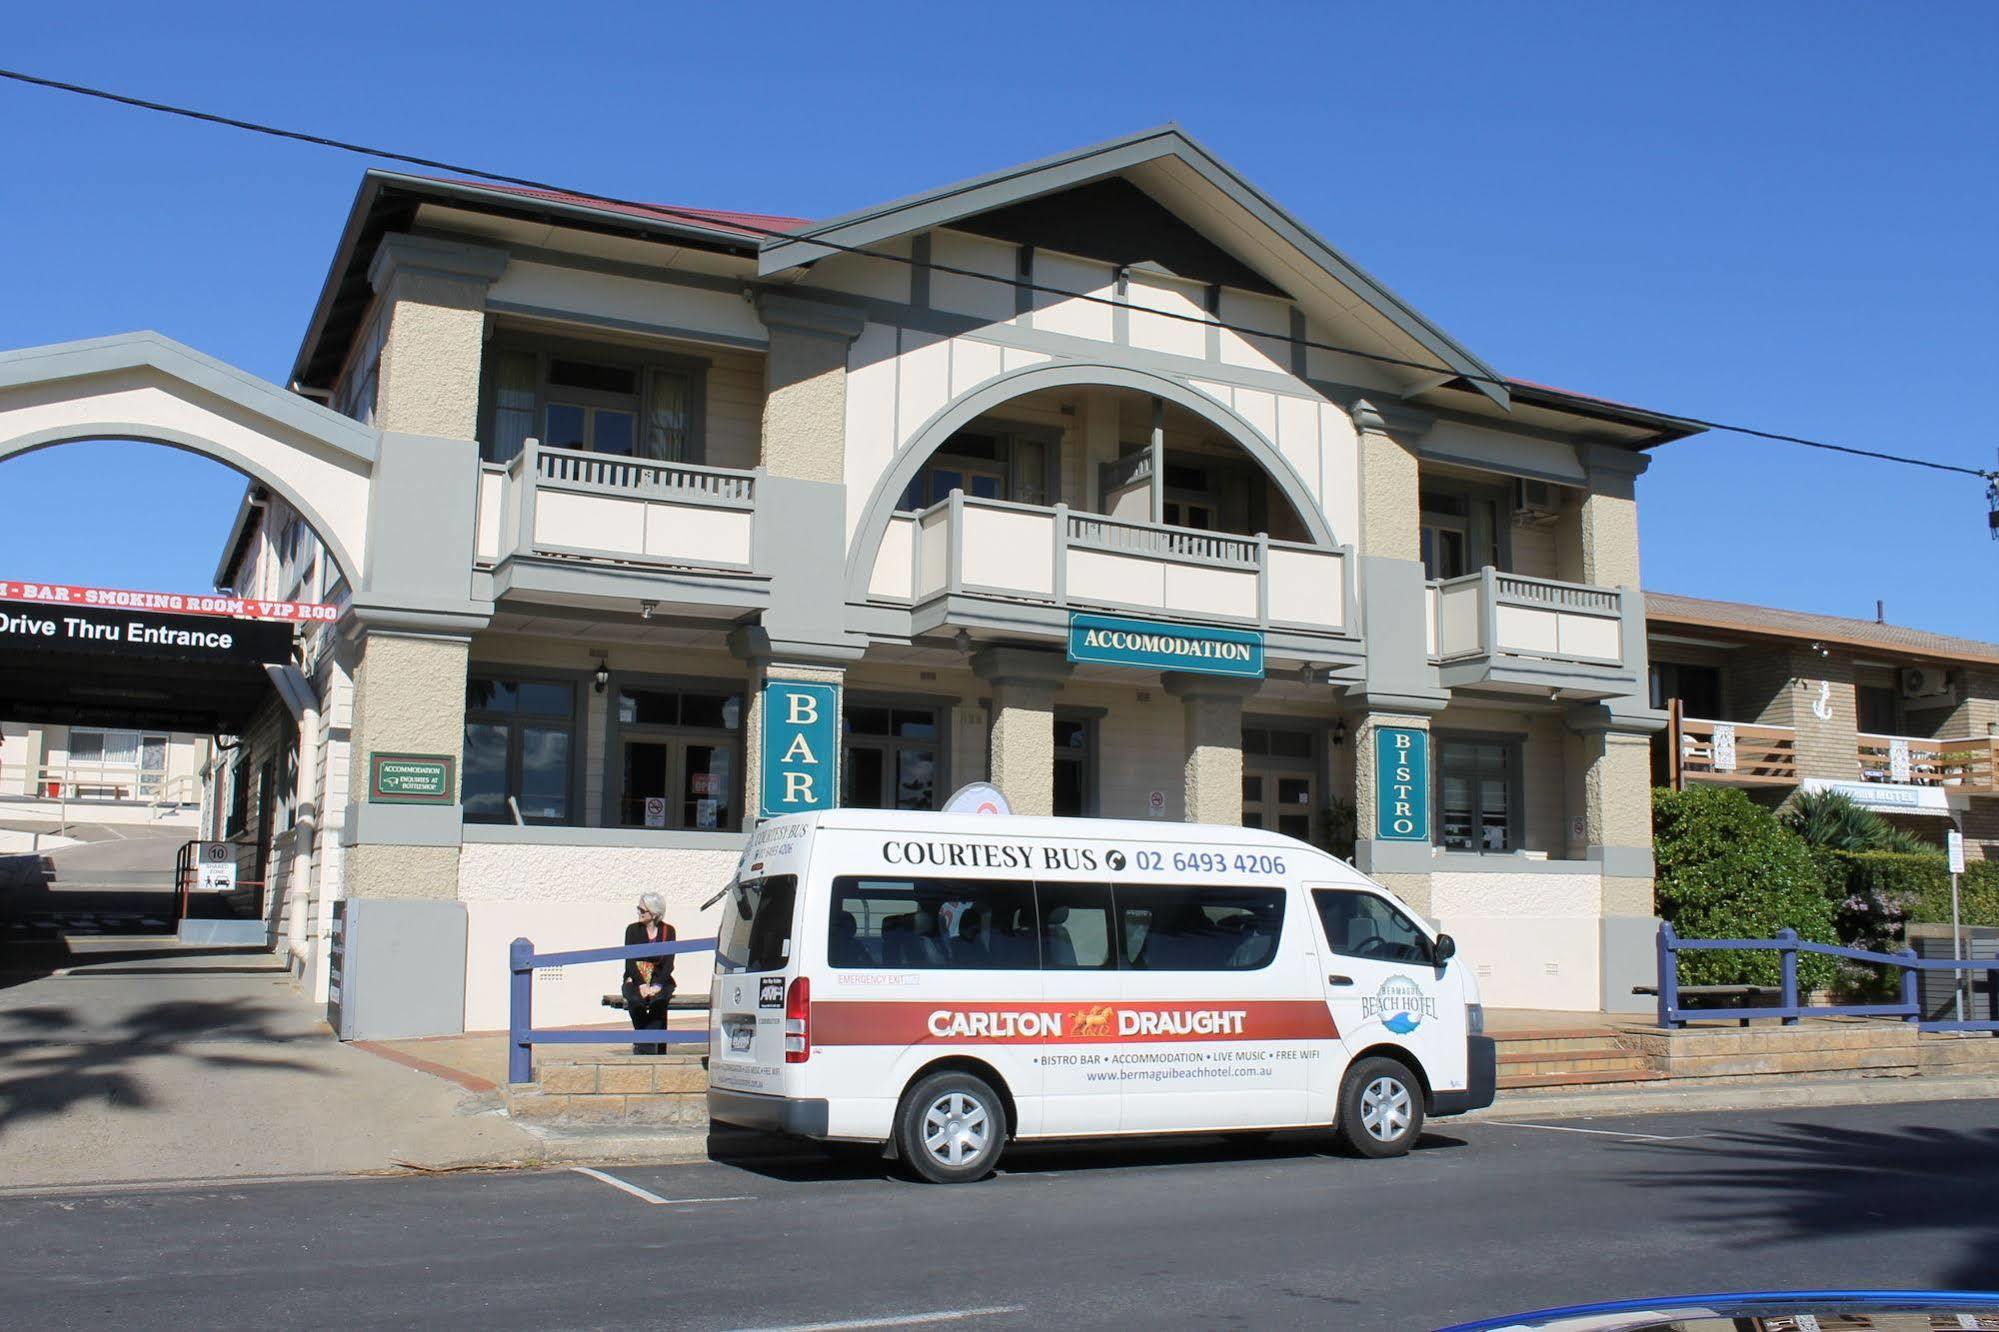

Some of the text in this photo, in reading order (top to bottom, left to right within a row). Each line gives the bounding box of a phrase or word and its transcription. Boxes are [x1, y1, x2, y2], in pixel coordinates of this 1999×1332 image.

[23, 584, 70, 601] BAR
[85, 589, 182, 610] SMOKING
[186, 597, 245, 614] ROOM
[258, 602, 294, 617] VIP
[63, 617, 120, 641] Thru
[127, 622, 233, 649] Entrance
[1084, 629, 1250, 661] ACCOMODATION
[781, 693, 818, 803] BAR
[1393, 734, 1413, 833] BISTRO
[1874, 790, 1915, 803] MOTEL
[212, 848, 225, 859] 10
[883, 840, 1286, 875] COURTESY BUS 02 6493 4206
[1362, 996, 1438, 1020] BEACH HOTEL
[928, 1010, 1247, 1037] CARLTON DRAUGHT
[1041, 1049, 1320, 1066] BISTRO BAR ACCOMMODATION LIVE MUSIC FREE WIFI
[1087, 1066, 1272, 1081] www.bermaguibeachhotel.com.au
